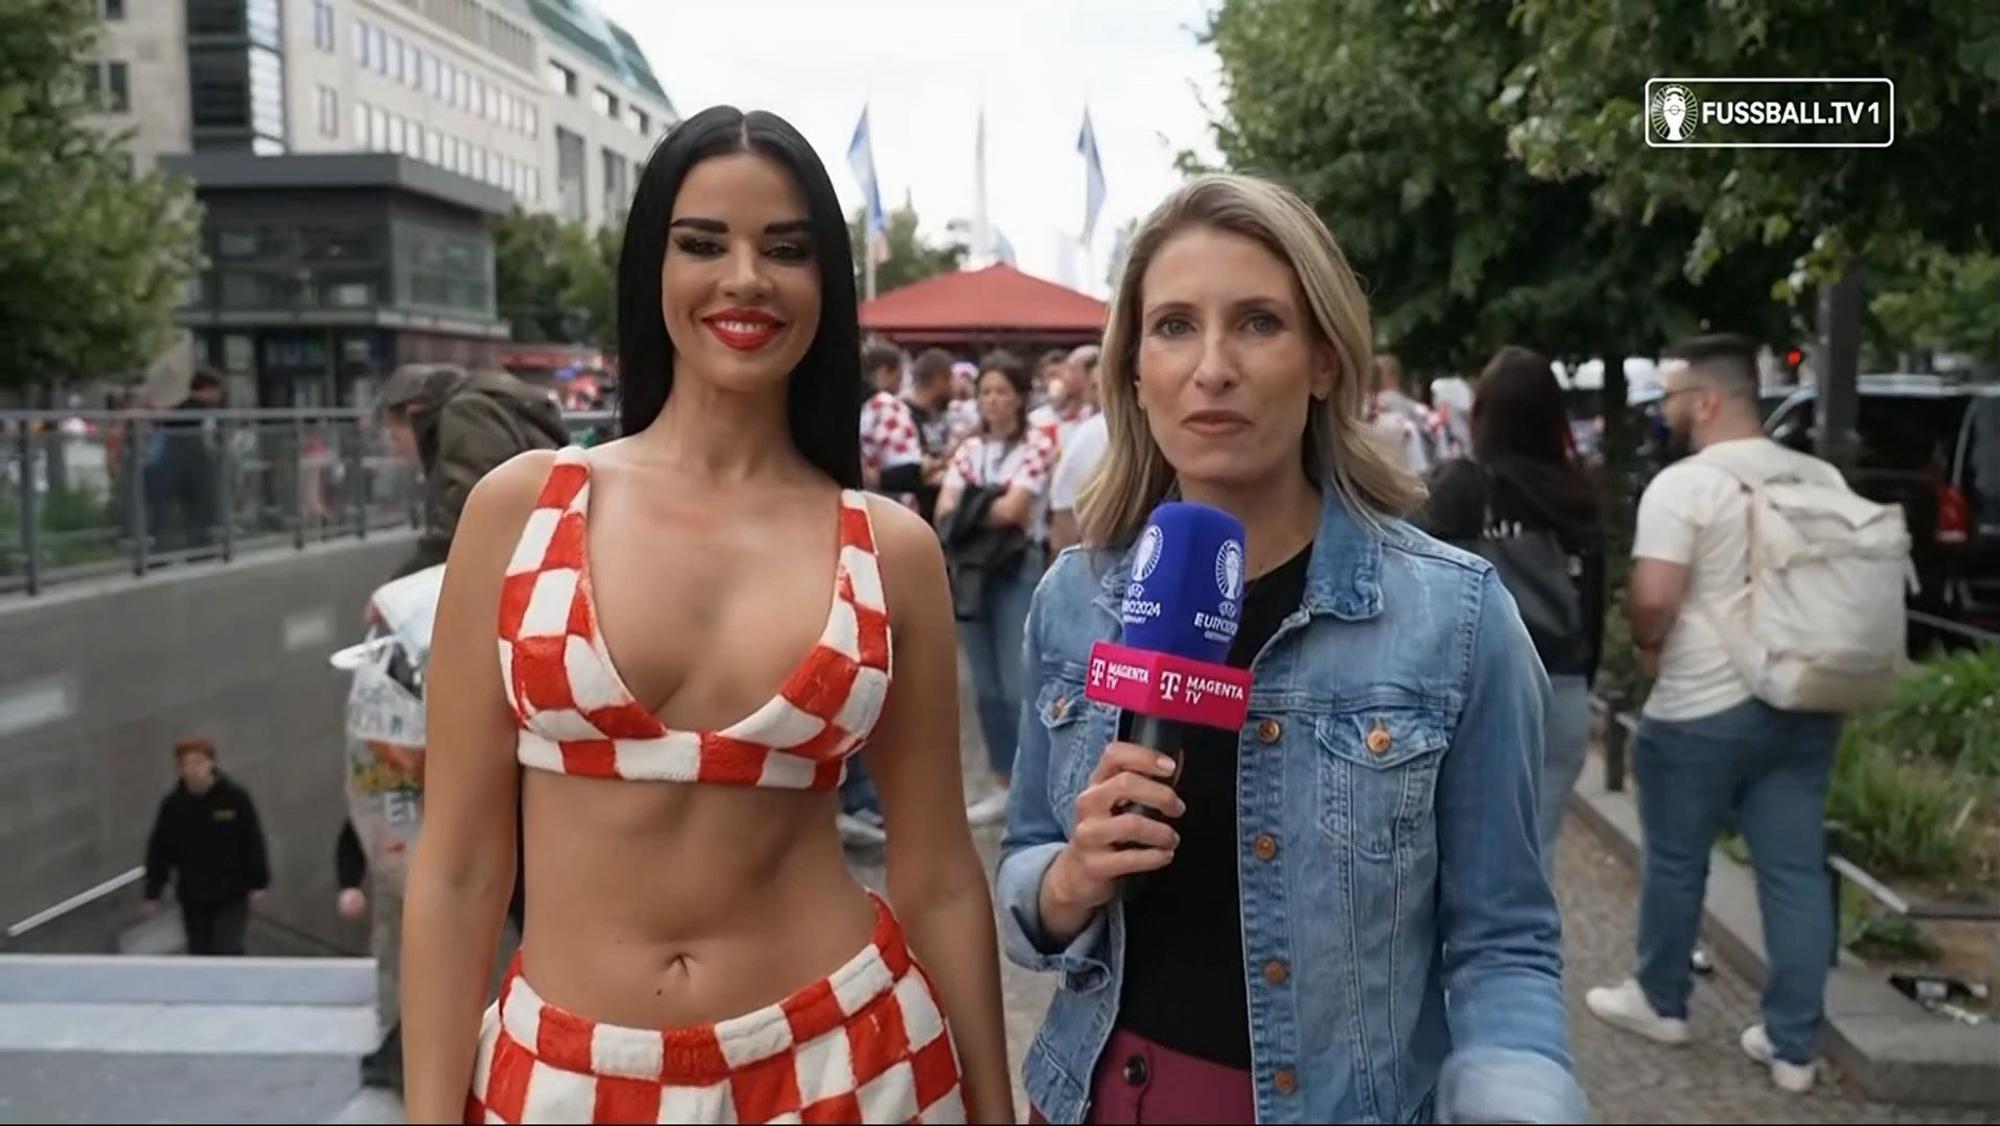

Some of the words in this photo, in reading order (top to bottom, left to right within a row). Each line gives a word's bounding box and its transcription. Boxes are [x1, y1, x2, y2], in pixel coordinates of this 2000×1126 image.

[1106, 674, 1119, 690] TV
[1108, 662, 1149, 684] MAGENTA
[1185, 676, 1244, 701] MAGENTA
[1185, 690, 1202, 705] TV
